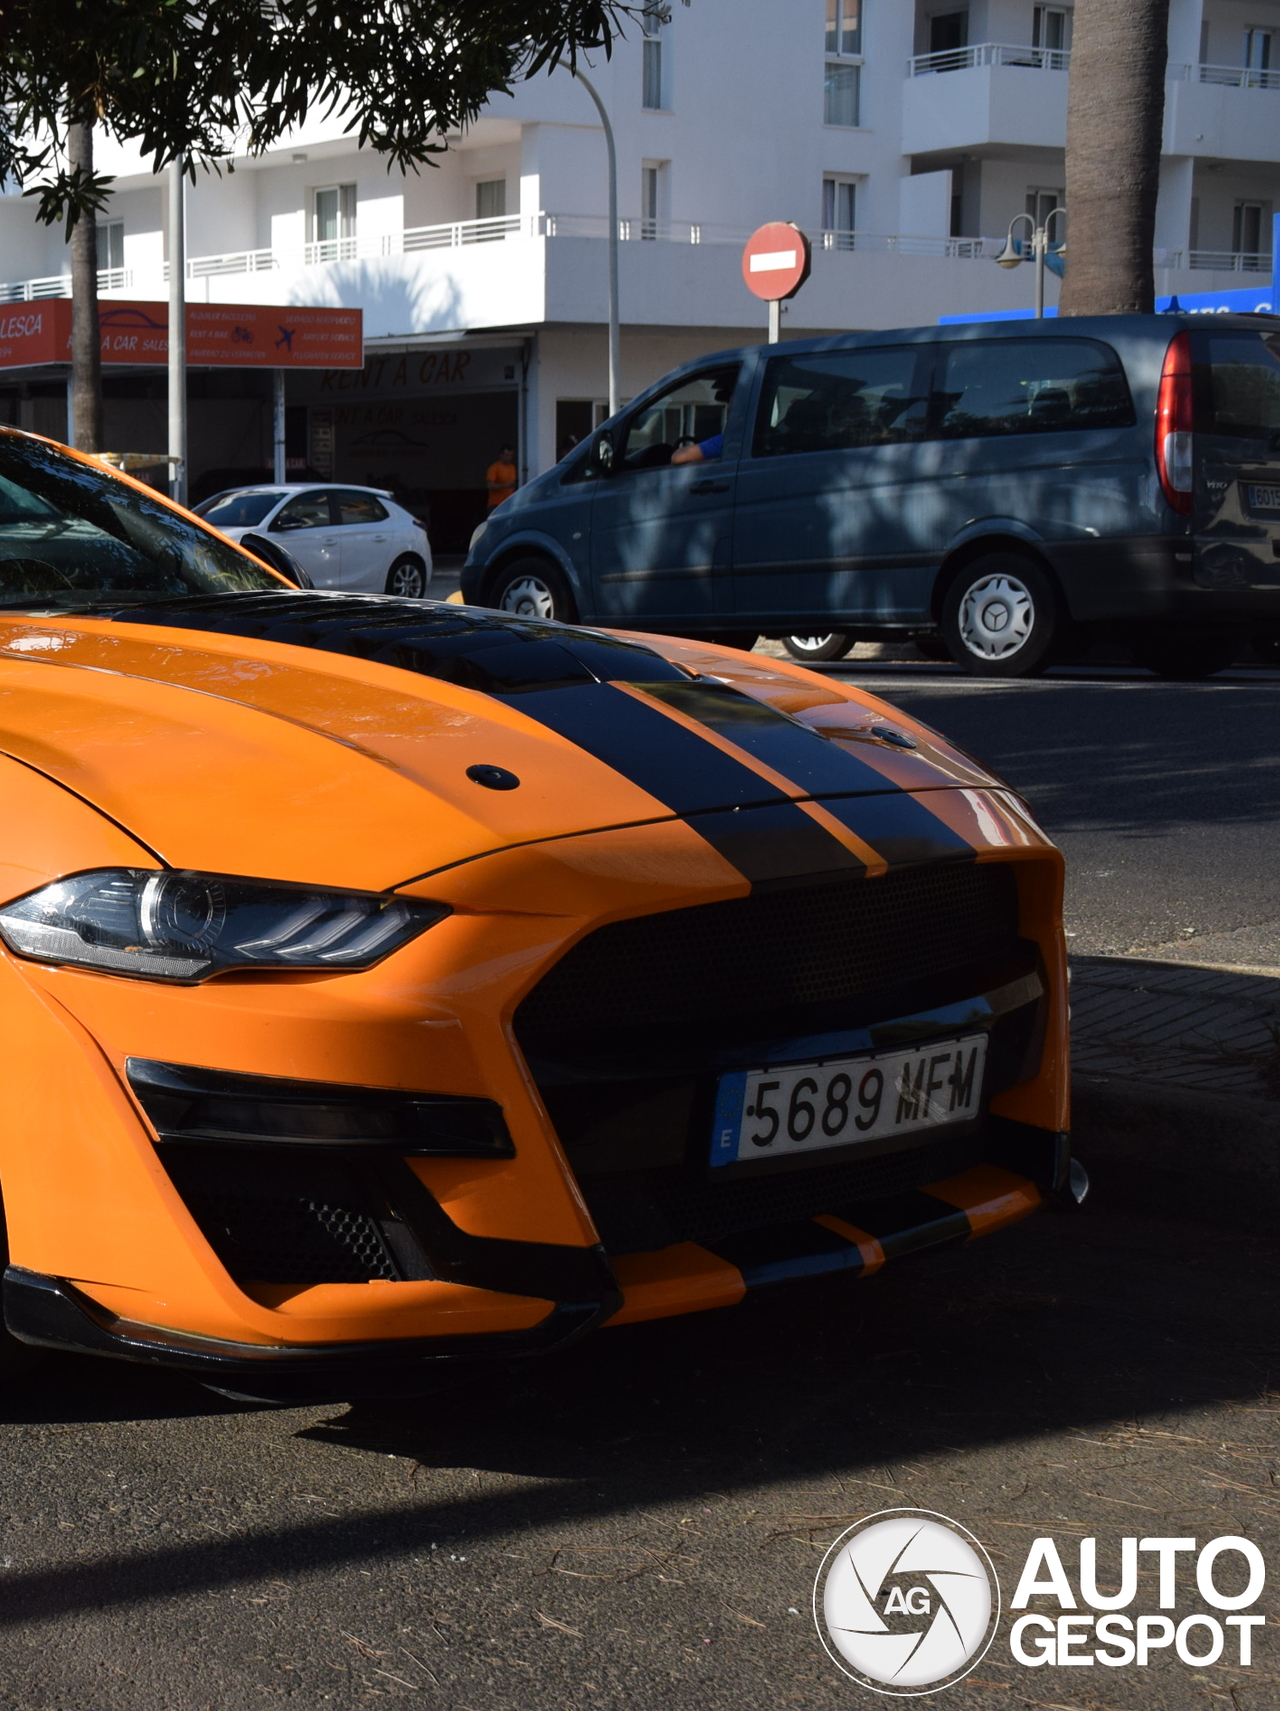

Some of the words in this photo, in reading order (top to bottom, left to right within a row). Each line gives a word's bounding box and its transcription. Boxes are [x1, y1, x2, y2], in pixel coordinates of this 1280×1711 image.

[100, 335, 110, 350] A
[113, 335, 138, 351] CAR
[141, 339, 169, 351] SALES
[393, 355, 408, 387] A
[419, 350, 472, 385] CAR
[751, 1068, 884, 1147] 5689
[895, 1047, 978, 1125] MFM
[720, 1129, 732, 1148] E
